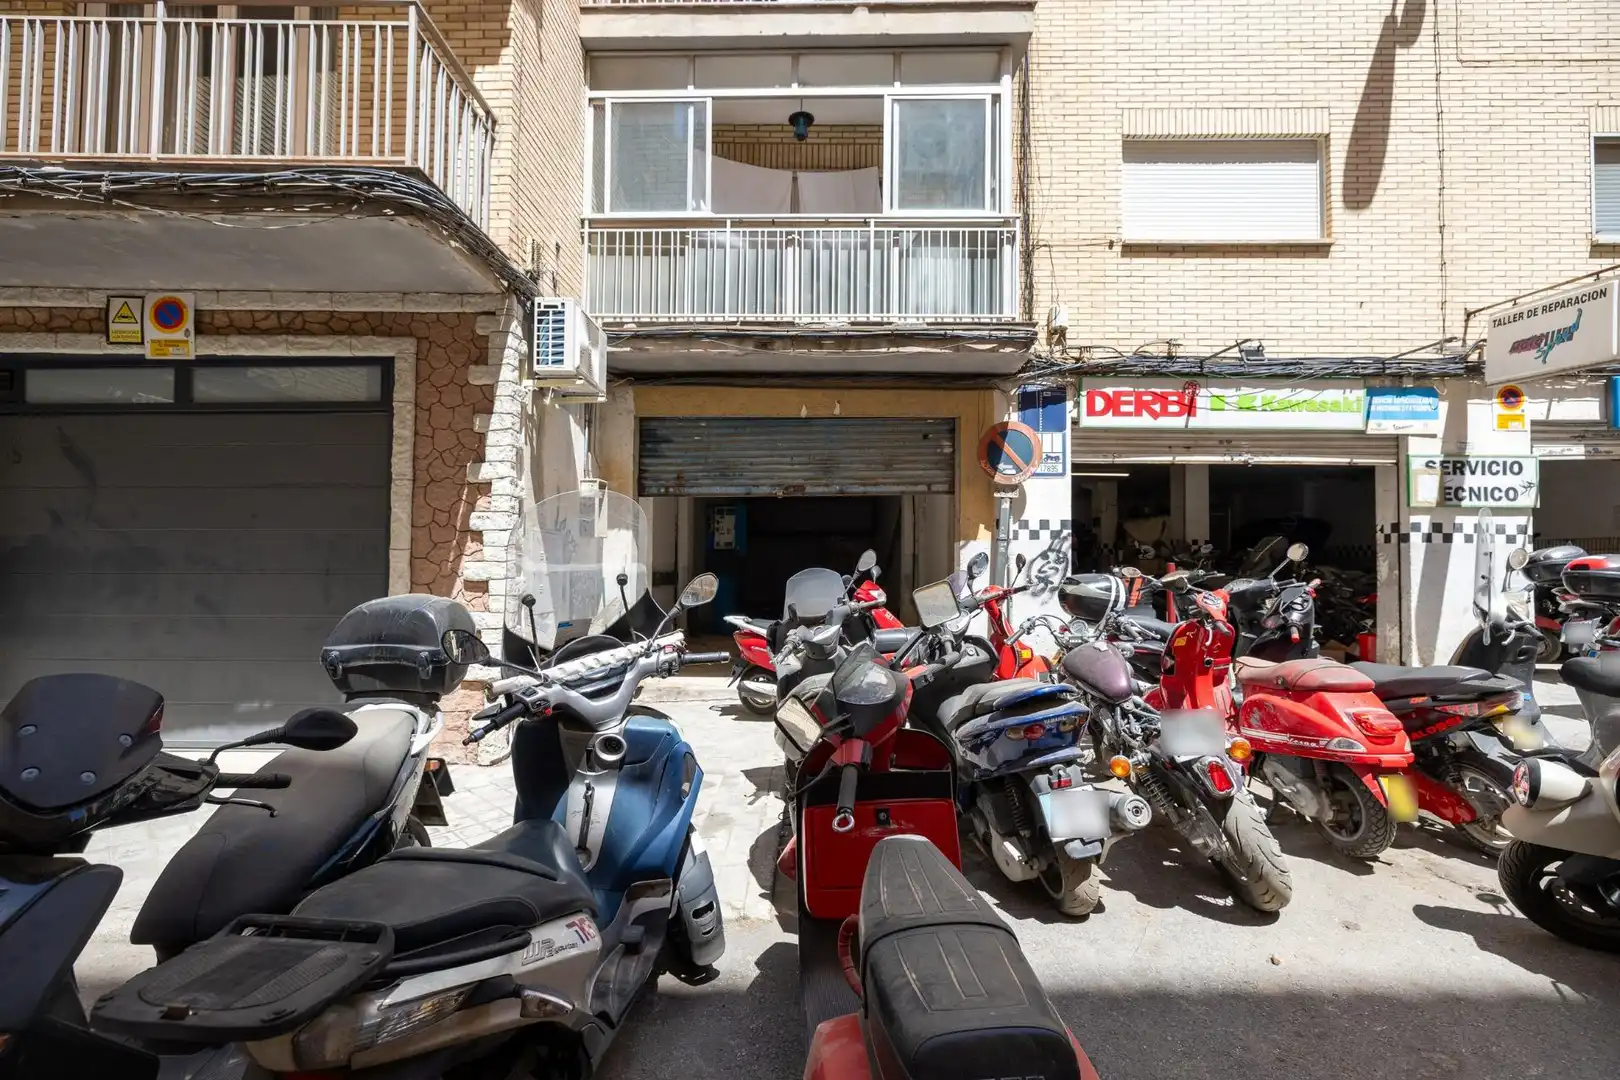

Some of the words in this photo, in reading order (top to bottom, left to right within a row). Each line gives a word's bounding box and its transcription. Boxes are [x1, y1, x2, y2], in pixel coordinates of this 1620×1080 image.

[1492, 311, 1524, 328] TALLER
[1527, 307, 1539, 319] DE
[1541, 287, 1608, 315] REPARACION
[1261, 395, 1361, 412] Kawasaki
[1425, 459, 1523, 476] SERVICIO
[1443, 486, 1519, 502] ECNICO
